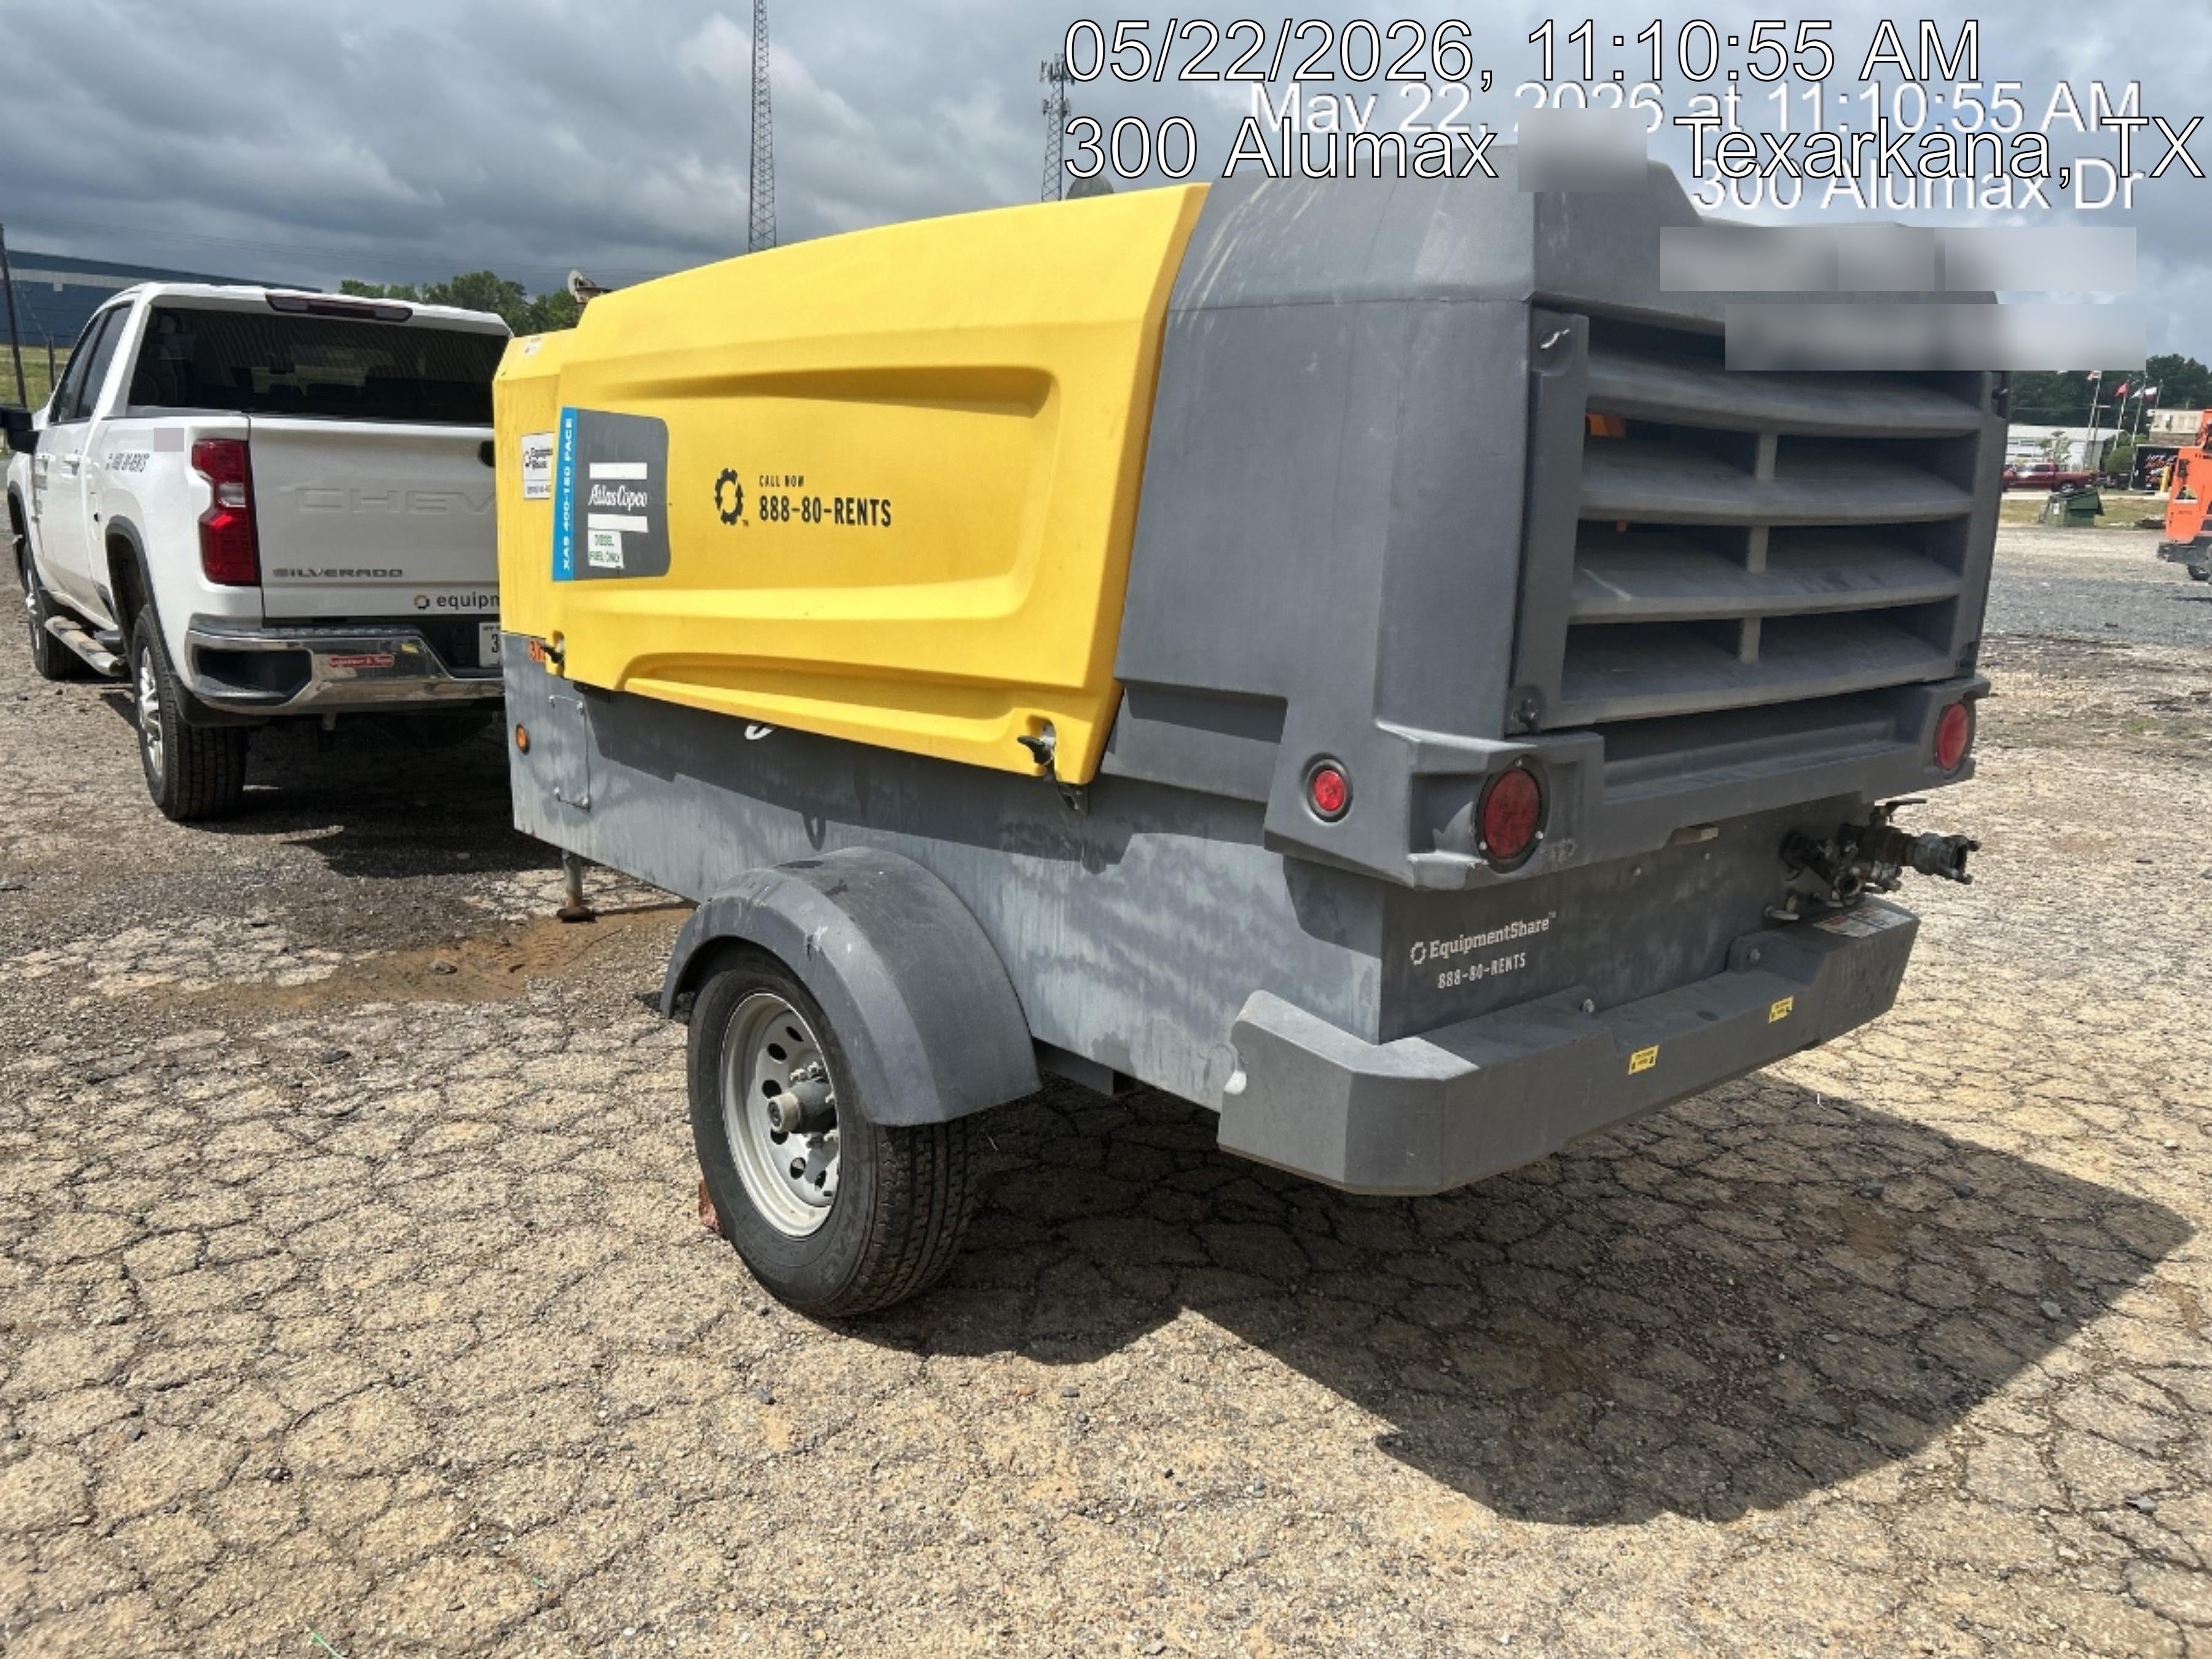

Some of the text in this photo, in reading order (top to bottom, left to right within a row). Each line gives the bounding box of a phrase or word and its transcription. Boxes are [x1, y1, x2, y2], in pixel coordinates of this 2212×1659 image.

[759, 475, 804, 487] CALL NOW
[759, 495, 892, 527] 888-80-RENTS
[272, 568, 403, 578] SILVERADO
[1437, 952, 1526, 989] 888-80-RENTS
